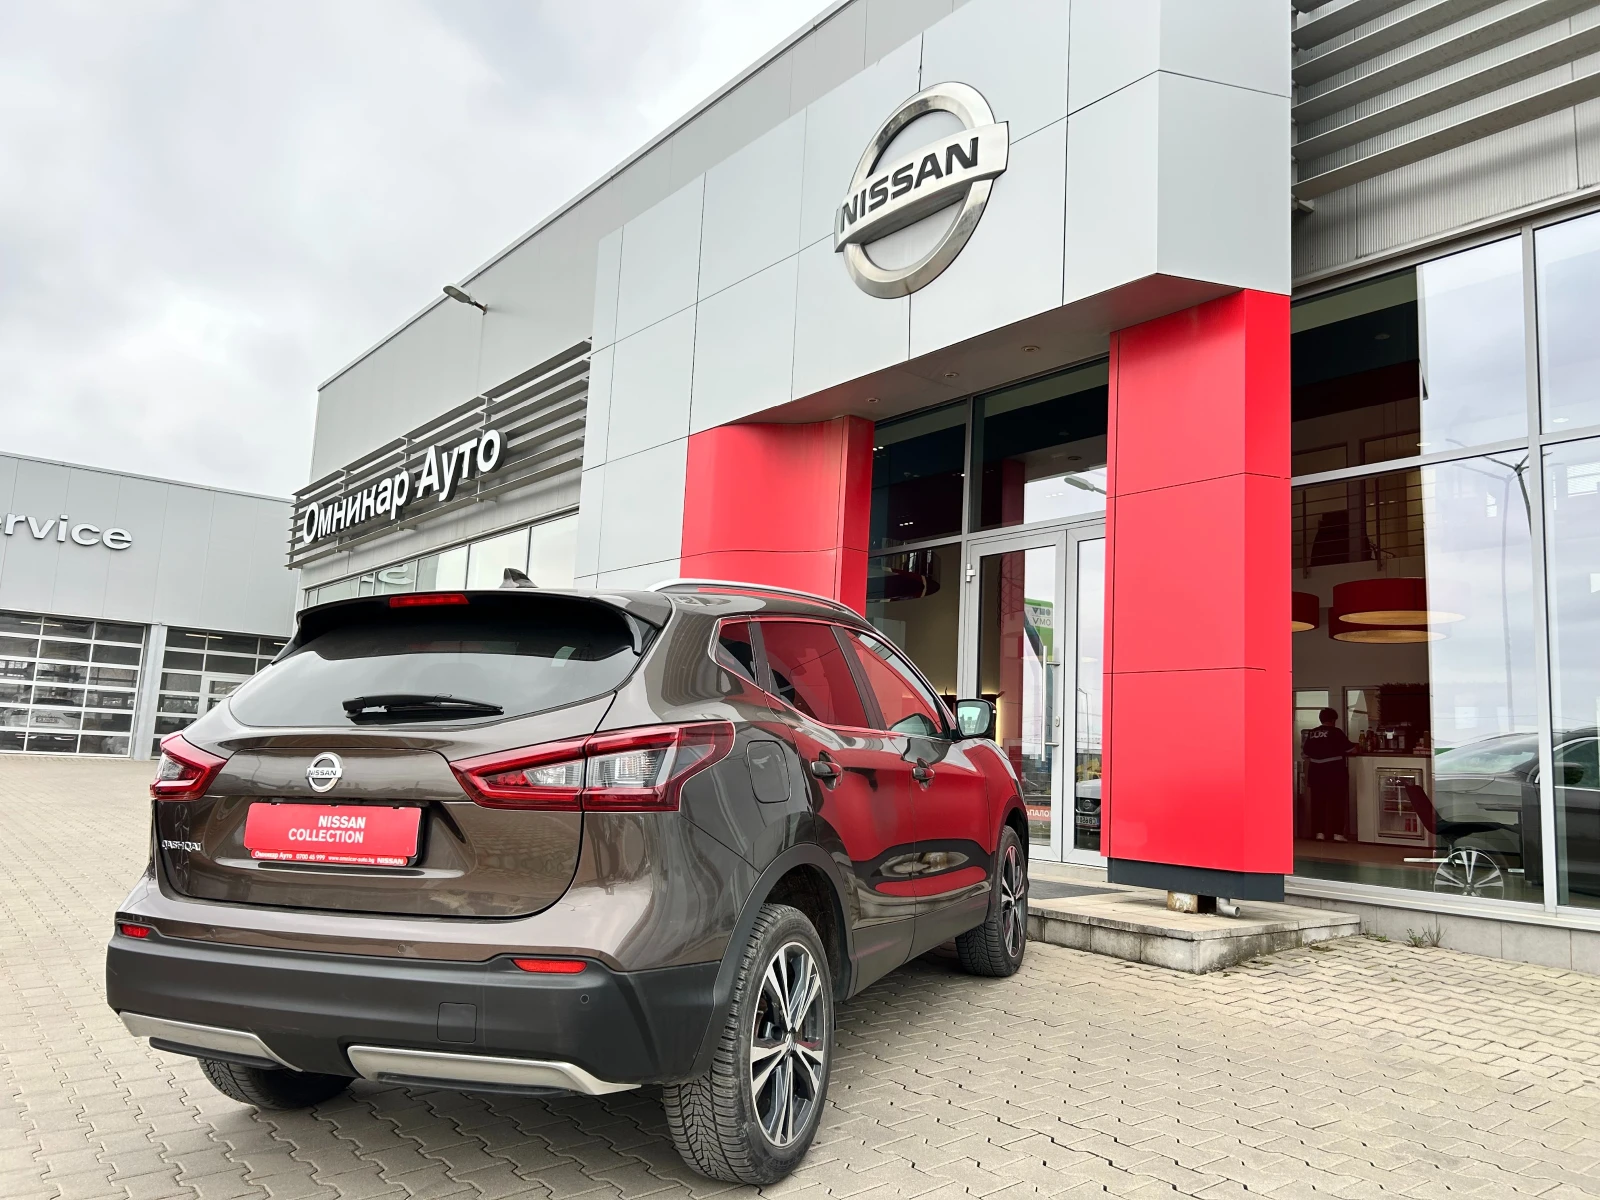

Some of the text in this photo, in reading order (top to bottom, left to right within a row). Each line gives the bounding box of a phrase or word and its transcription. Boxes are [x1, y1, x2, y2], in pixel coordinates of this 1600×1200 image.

[840, 136, 979, 233] NISSAN
[303, 429, 501, 544] Омникар Ауто
[0, 513, 132, 550] rvice
[318, 815, 366, 829] NISSAN
[288, 828, 364, 844] COLLECTION
[161, 840, 202, 852] QASHQAI
[376, 857, 404, 865] NISSAN
